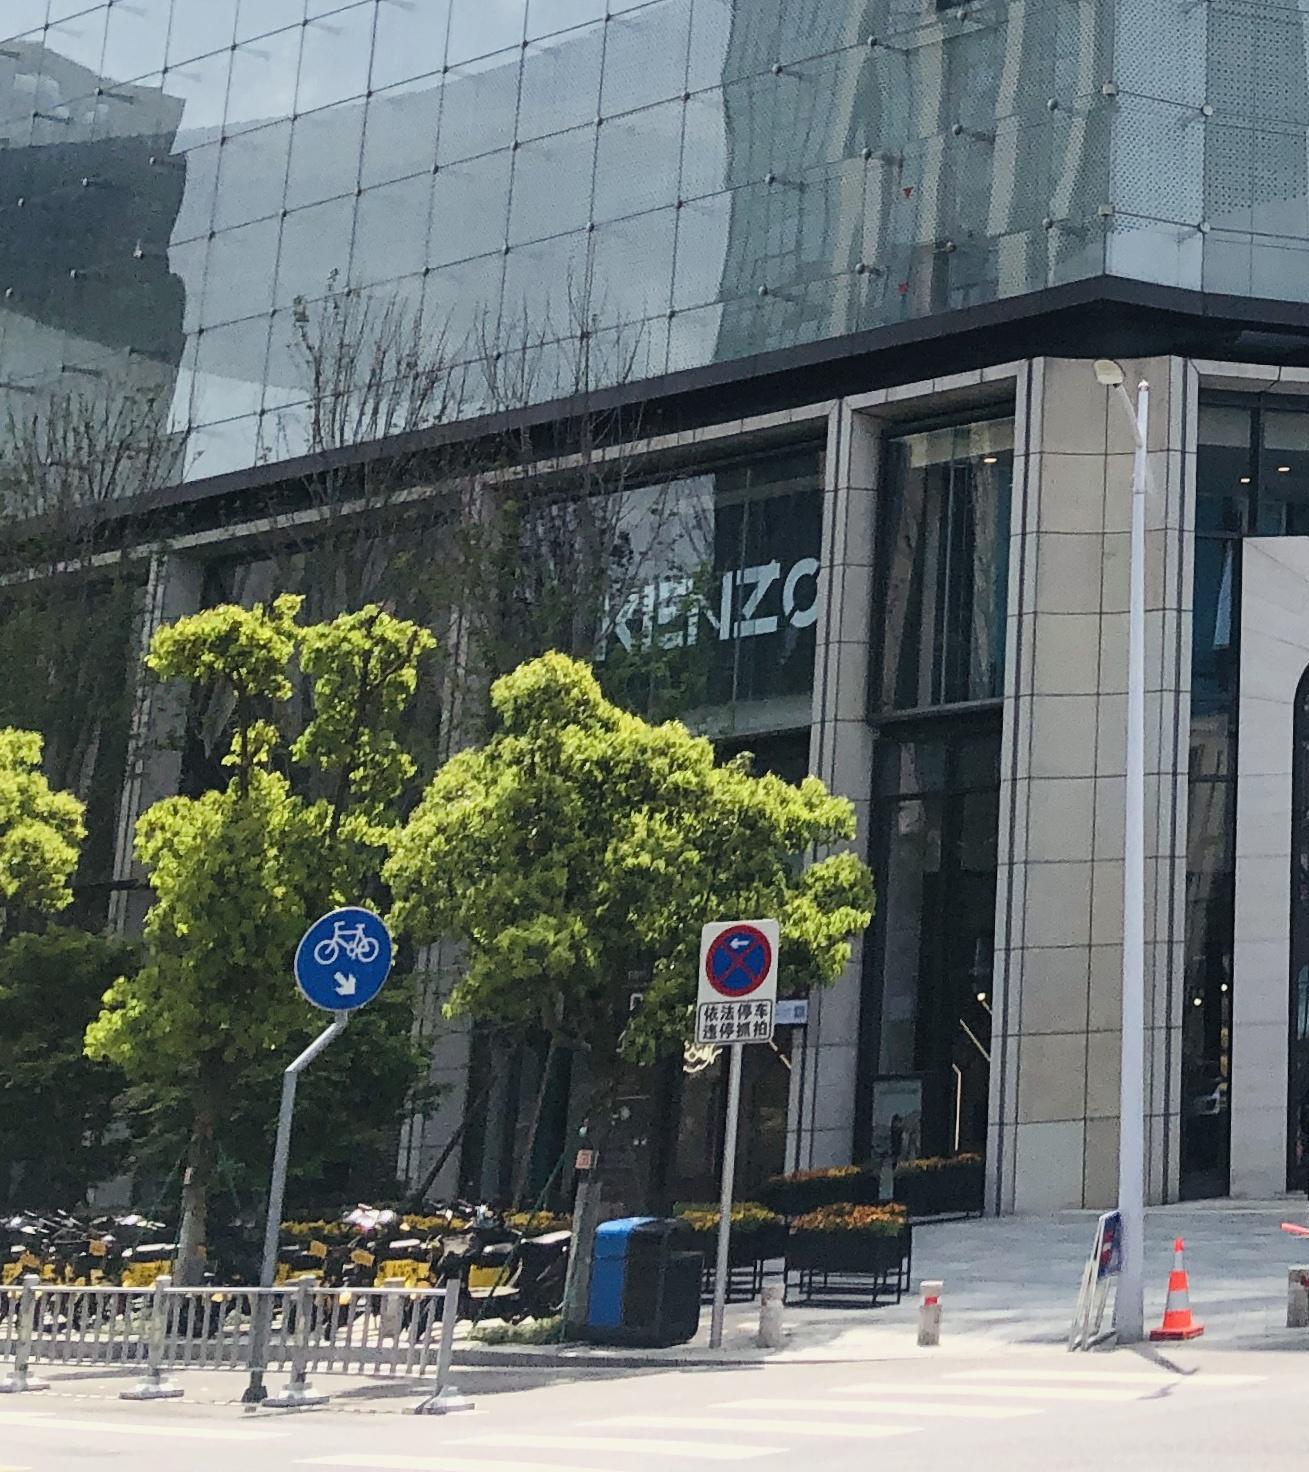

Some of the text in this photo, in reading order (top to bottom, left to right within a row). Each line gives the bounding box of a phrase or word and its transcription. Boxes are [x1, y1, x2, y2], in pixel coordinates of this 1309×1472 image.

[595, 557, 819, 661] KENZO
[703, 1003, 768, 1022] 依法停车
[702, 1021, 767, 1040] 违停抓拍
